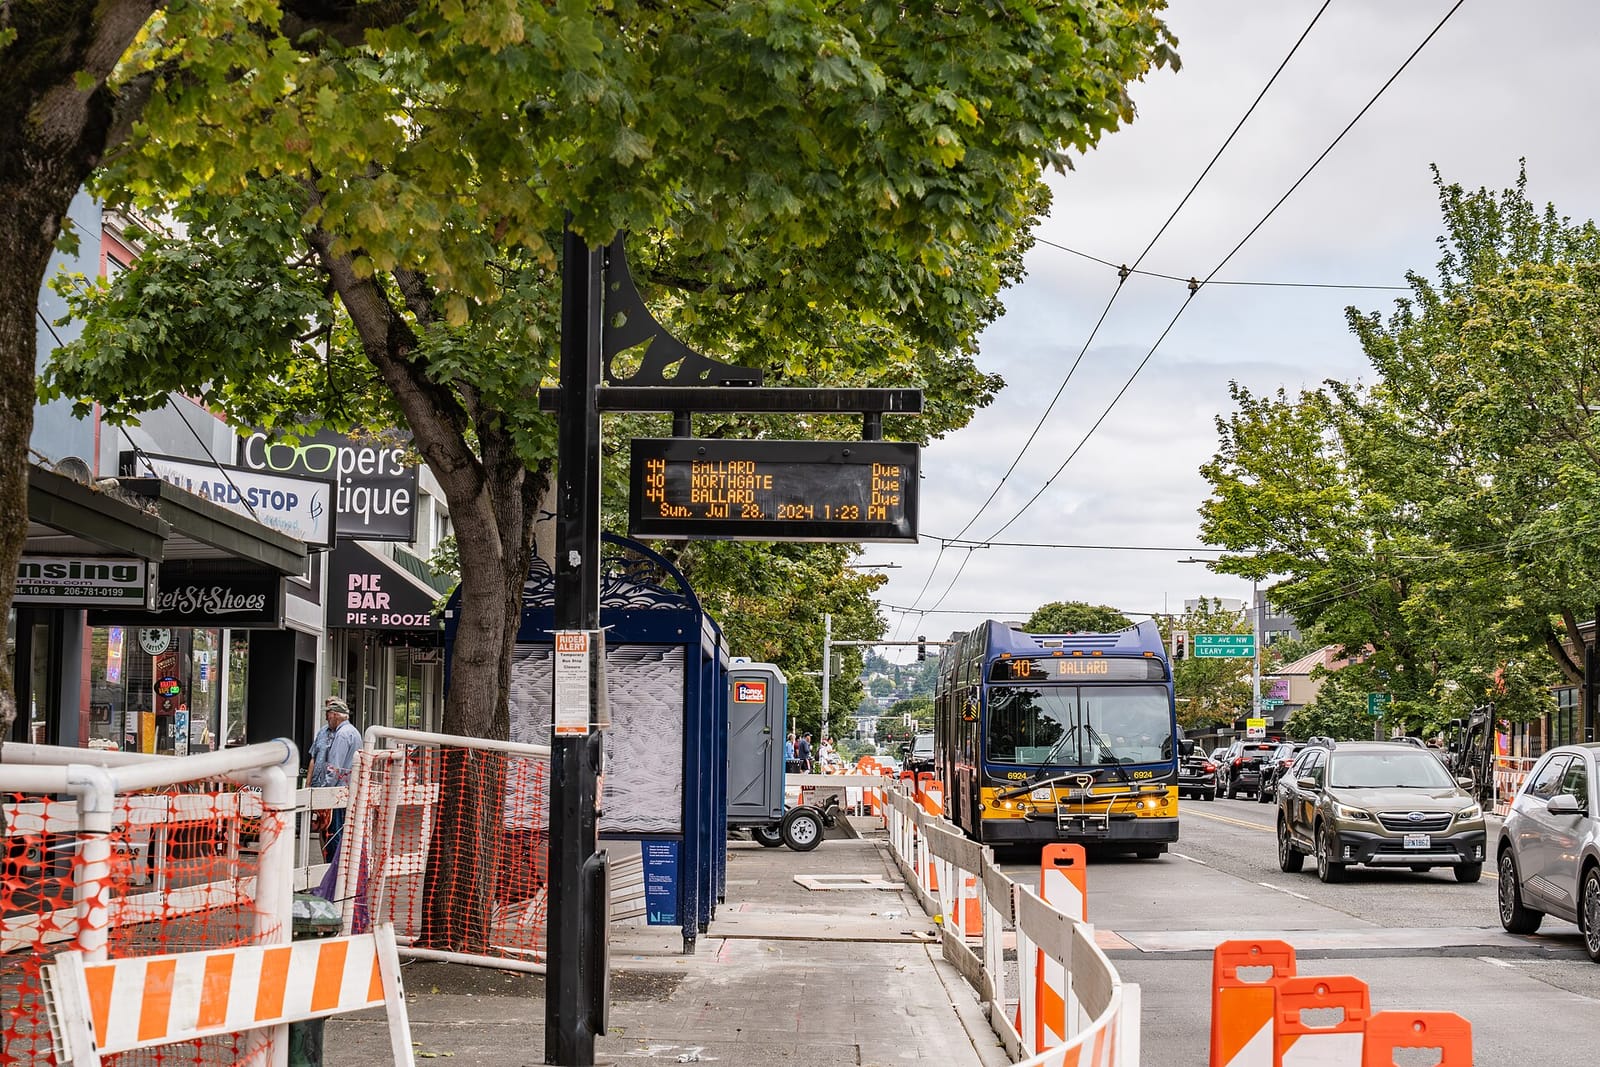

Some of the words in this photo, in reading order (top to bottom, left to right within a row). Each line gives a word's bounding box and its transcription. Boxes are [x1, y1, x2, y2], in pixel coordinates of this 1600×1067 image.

[646, 459, 665, 473] 44
[692, 460, 755, 474] BALLARD
[872, 463, 900, 477] Due
[646, 474, 665, 488] 40
[691, 475, 773, 489] NORTHGATE
[872, 477, 899, 491] Due
[247, 486, 298, 511] STOP
[337, 478, 410, 525] tique
[646, 488, 665, 502] 44
[691, 489, 754, 503] BALLARD
[871, 492, 899, 506] Due
[705, 503, 728, 518] Jul
[777, 505, 814, 519] 2024
[824, 505, 859, 520] 1:23
[868, 505, 886, 520] PM
[18, 562, 138, 582] nsing
[348, 574, 381, 591] PIE
[14, 587, 26, 595] at.
[29, 586, 38, 595] 10
[50, 587, 56, 595] 6
[64, 587, 124, 597] 206-781-0199
[347, 592, 391, 609] BAR
[346, 612, 367, 625] PIE
[381, 613, 431, 626] BOOZE
[558, 643, 585, 651] ALERT
[559, 635, 585, 643] RIDER
[1202, 636, 1213, 644] 22
[1200, 647, 1223, 655] LEARY
[1012, 659, 1030, 677] 40
[1059, 660, 1108, 674] BALLARD
[1007, 772, 1027, 780] 6924
[1133, 771, 1153, 779] 6924
